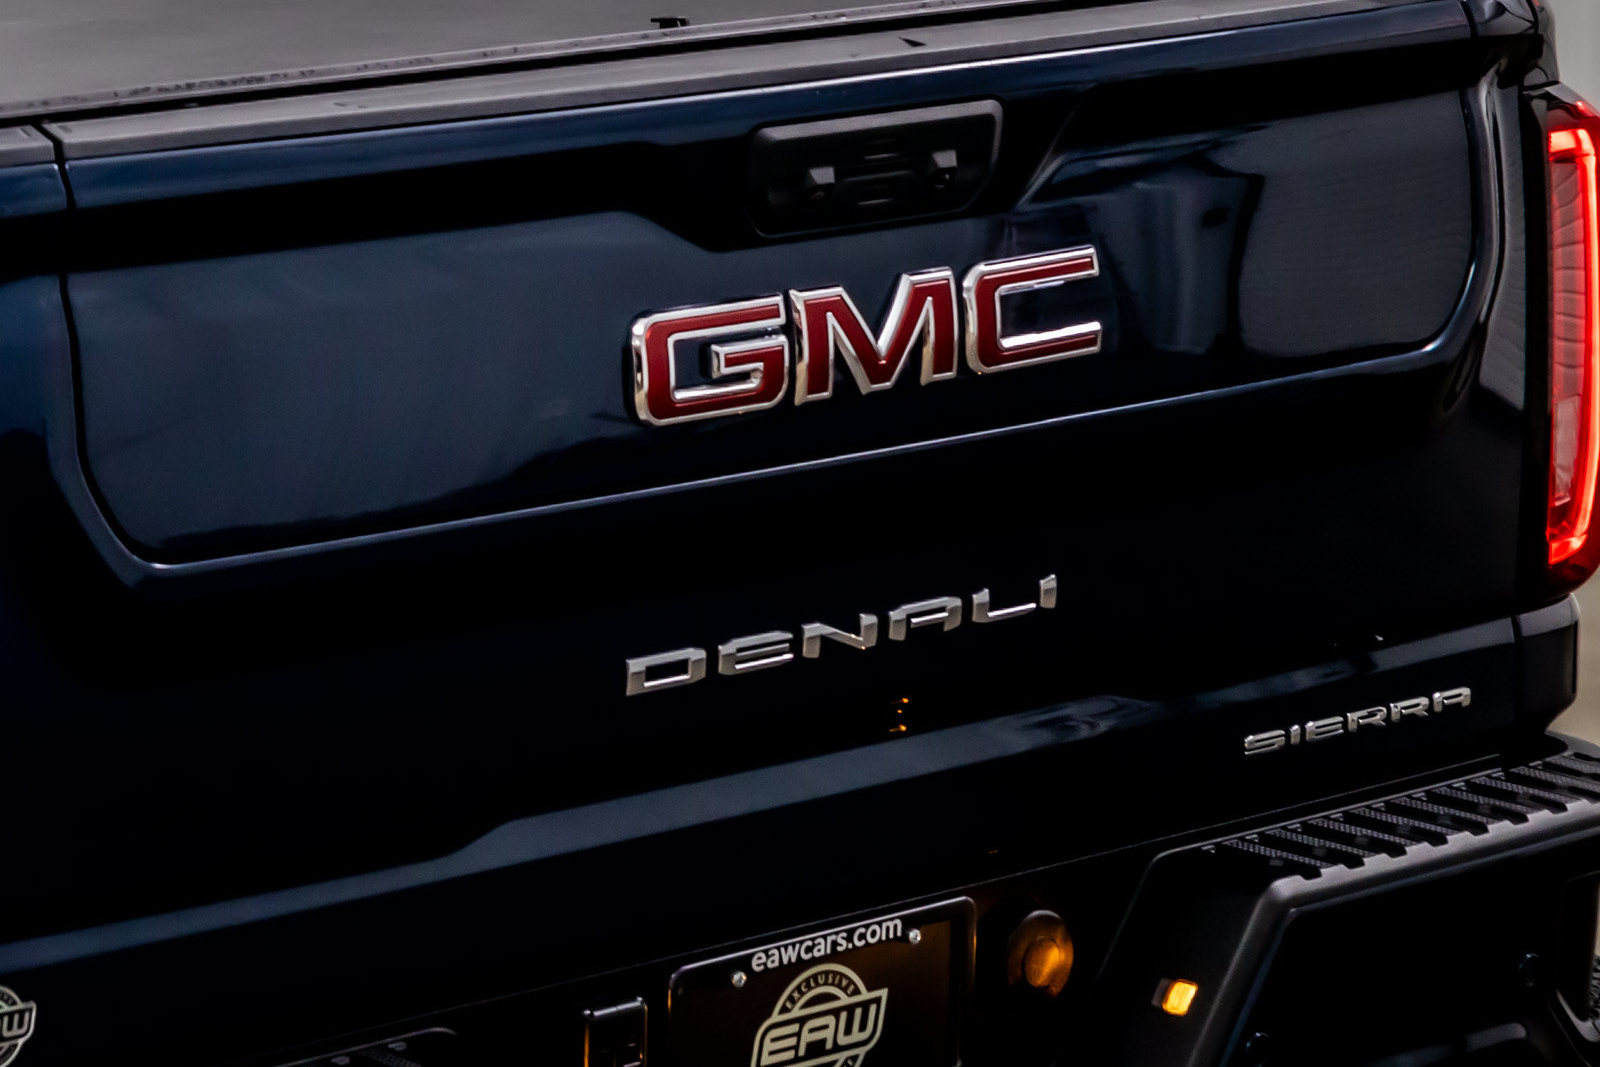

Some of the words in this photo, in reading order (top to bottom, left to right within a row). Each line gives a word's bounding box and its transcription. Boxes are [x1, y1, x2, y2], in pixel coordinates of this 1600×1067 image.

[630, 244, 1103, 427] GMC
[625, 573, 1058, 697] DENALI
[1243, 686, 1473, 756] SIERRA
[751, 918, 903, 972] eawcars.com
[784, 973, 856, 1010] EXCLUSIVE
[760, 1004, 877, 1067] EAW
